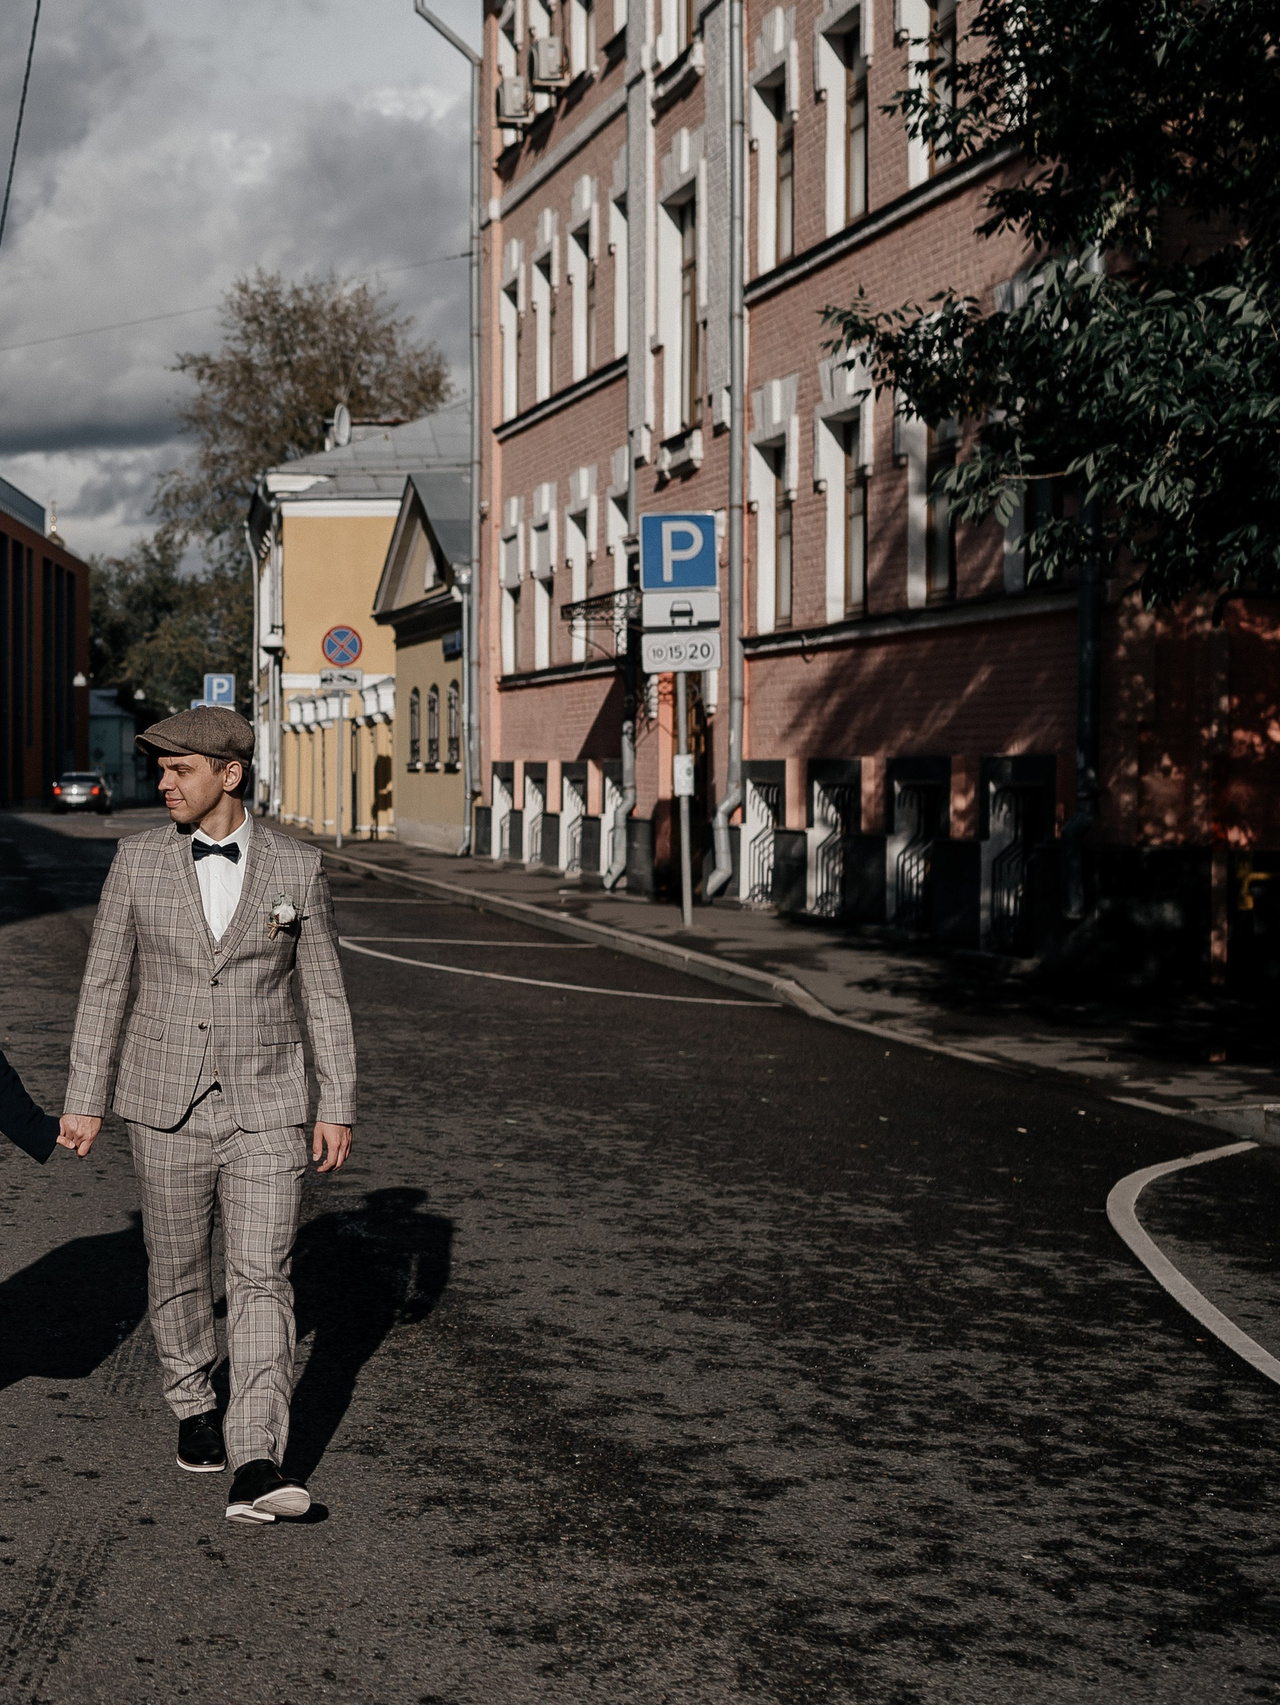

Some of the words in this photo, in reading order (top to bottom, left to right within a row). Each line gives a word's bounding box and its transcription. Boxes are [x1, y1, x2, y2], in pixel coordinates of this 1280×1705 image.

[661, 520, 704, 583] P
[652, 647, 664, 659] 10
[669, 645, 683, 659] 15
[688, 643, 711, 660] 20
[212, 678, 230, 701] P
